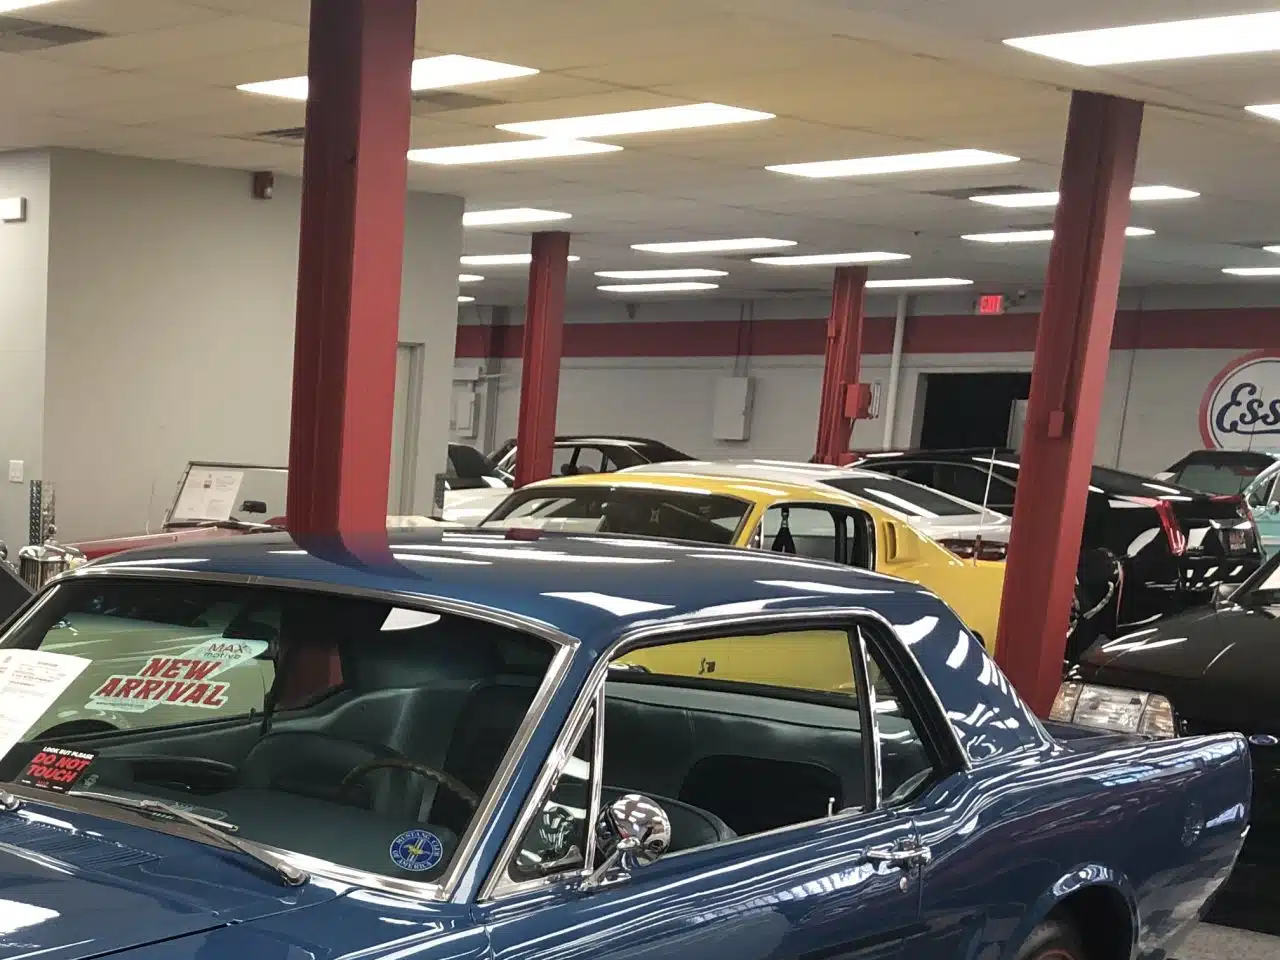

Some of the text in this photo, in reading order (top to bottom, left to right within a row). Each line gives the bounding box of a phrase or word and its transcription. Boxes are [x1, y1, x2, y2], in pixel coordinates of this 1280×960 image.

[203, 652, 242, 661] motive
[208, 643, 246, 654] MAX
[138, 657, 222, 681] NEW
[94, 677, 229, 706] ARRIVAL
[31, 752, 91, 771] DO NOT
[71, 751, 95, 760] PLEASE
[26, 764, 78, 783] TOUCH
